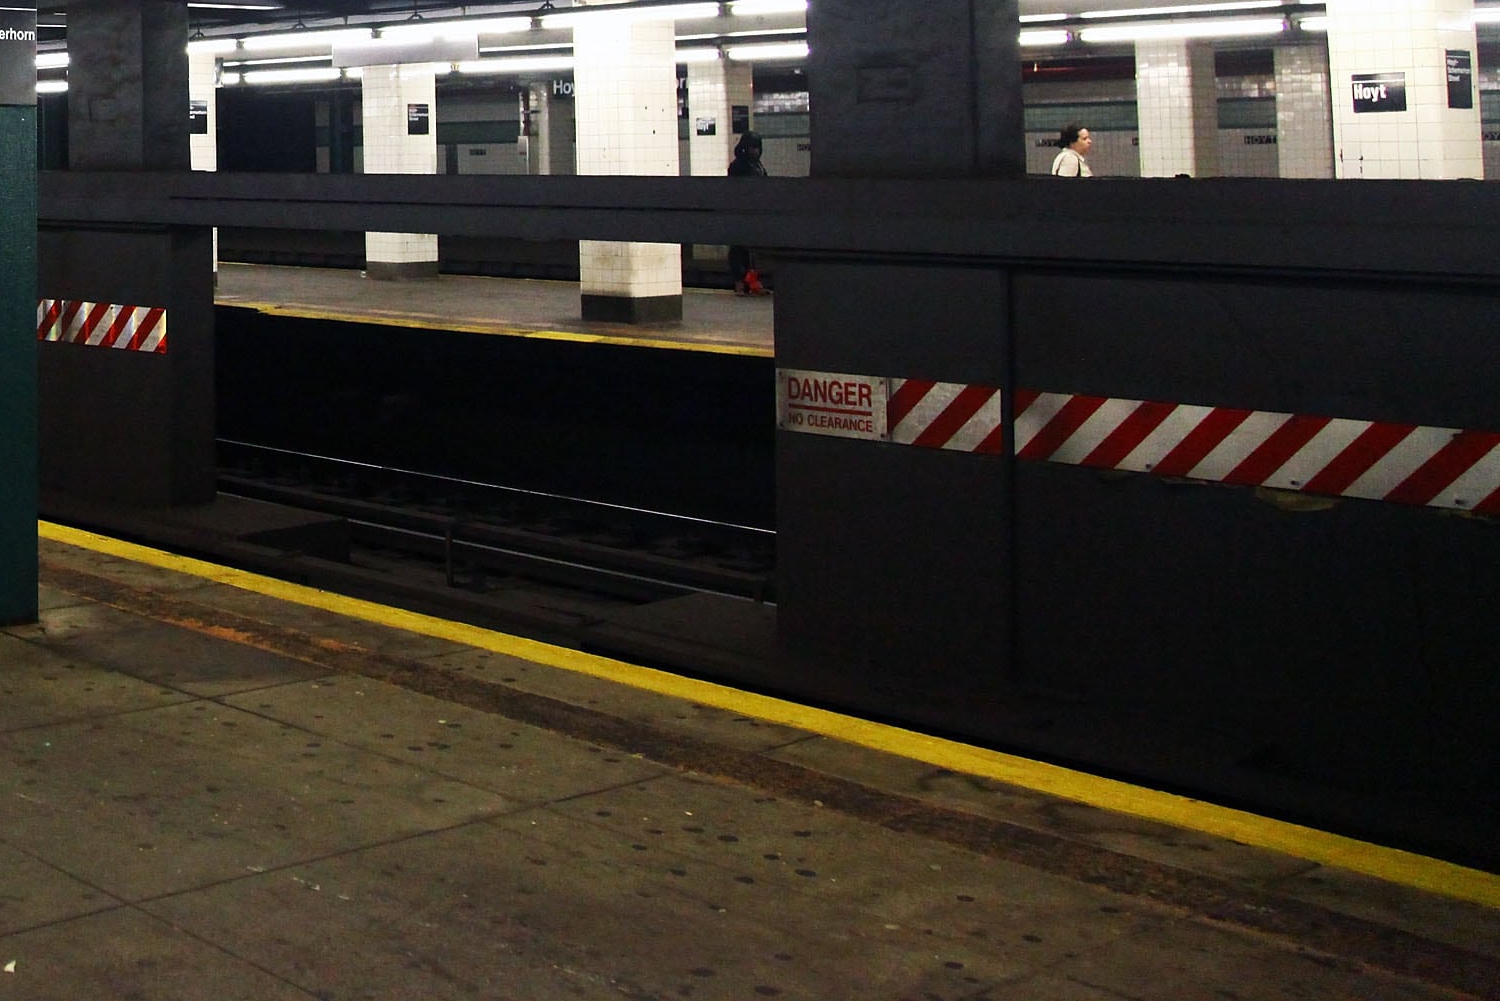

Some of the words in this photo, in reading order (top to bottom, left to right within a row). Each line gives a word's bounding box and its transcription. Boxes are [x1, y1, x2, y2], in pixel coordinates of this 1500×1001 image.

[1353, 83, 1387, 102] Hoyt
[787, 376, 872, 408] DANGER
[788, 412, 804, 426] NO
[807, 414, 873, 433] CLEARANCE
